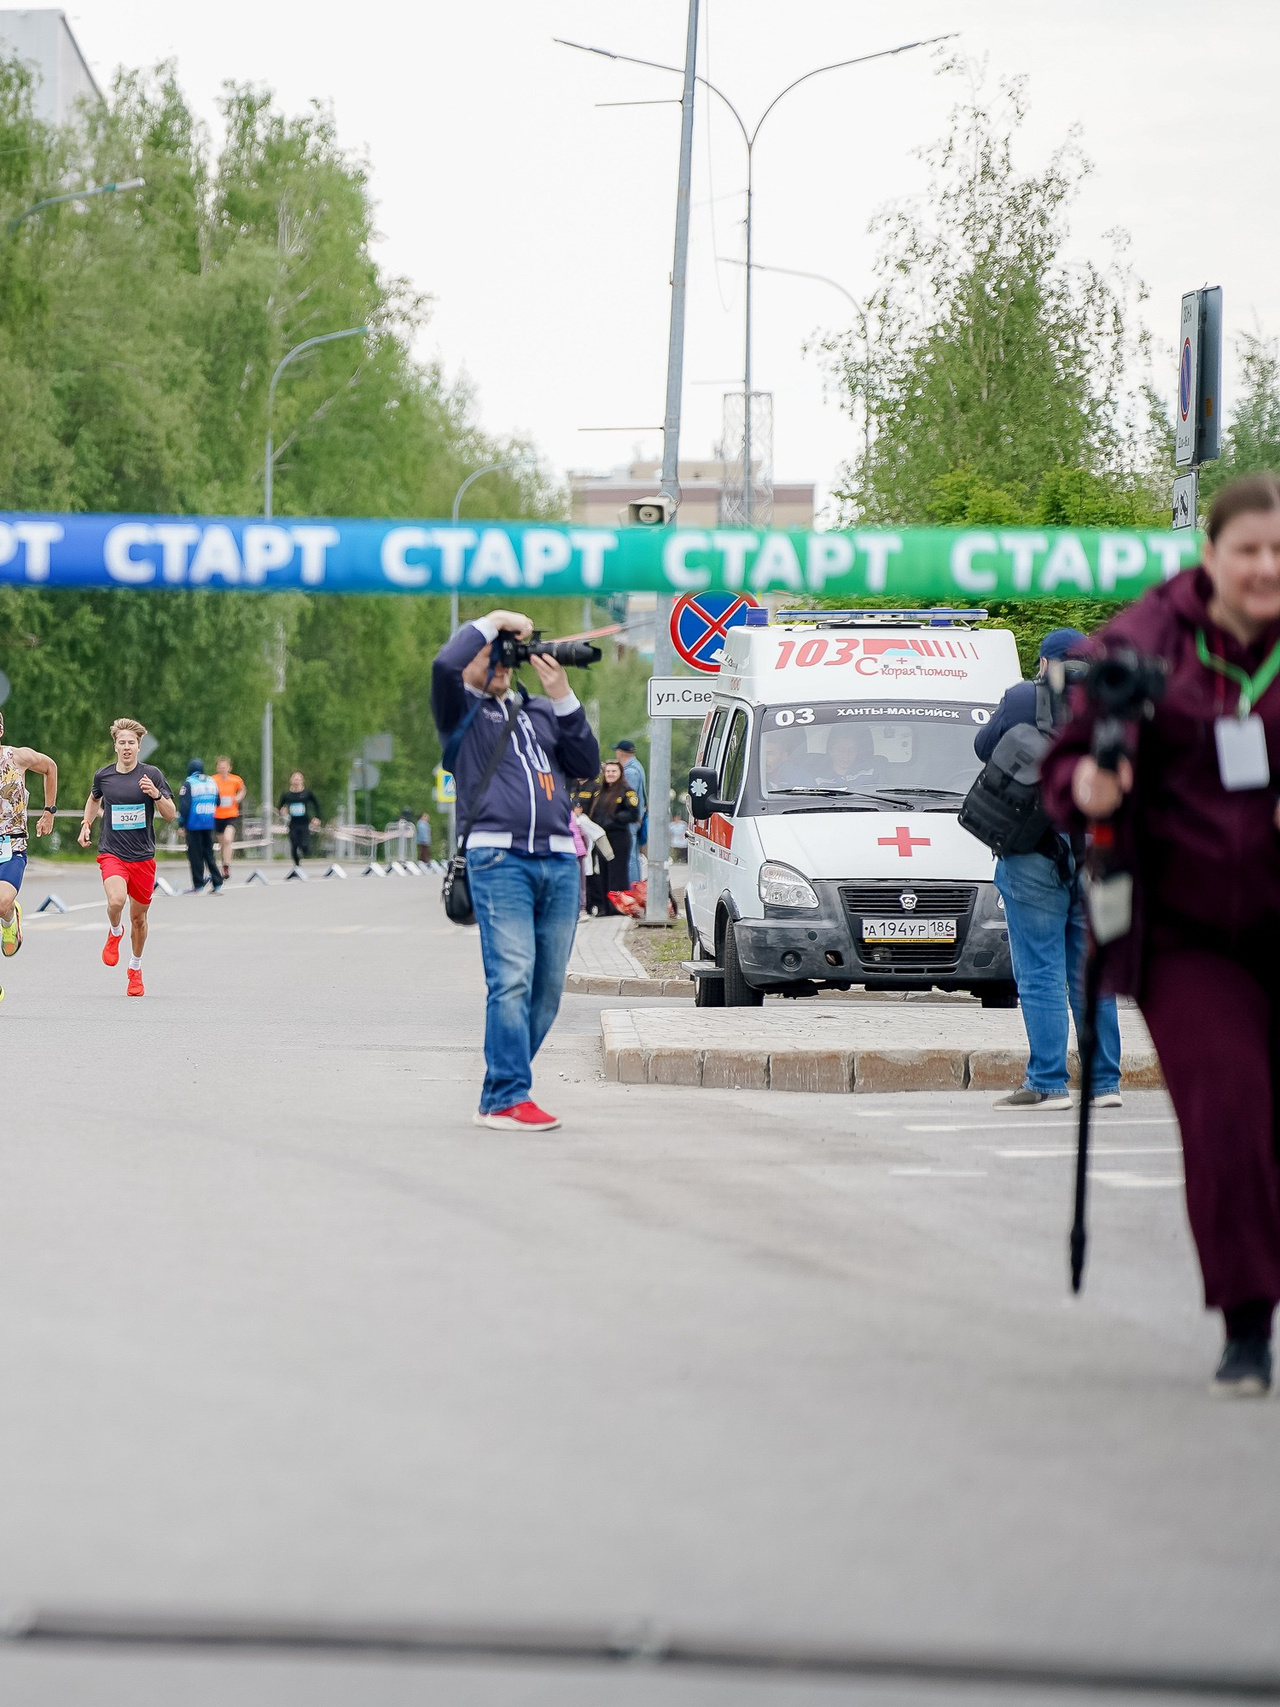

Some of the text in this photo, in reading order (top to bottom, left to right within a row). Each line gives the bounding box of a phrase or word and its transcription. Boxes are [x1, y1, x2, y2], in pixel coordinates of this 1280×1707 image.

[103, 521, 340, 586] СТАРТ
[380, 526, 619, 590] СТАРТ
[662, 530, 903, 593] СТАРТ
[949, 533, 1197, 595] СТАРТ
[775, 638, 860, 669] 103
[855, 657, 968, 680] Скорая помощь
[775, 706, 995, 726] 03 ХАНТЫ-МАНСИЙСК 0
[120, 814, 138, 822] 3347
[930, 922, 952, 932] 186
